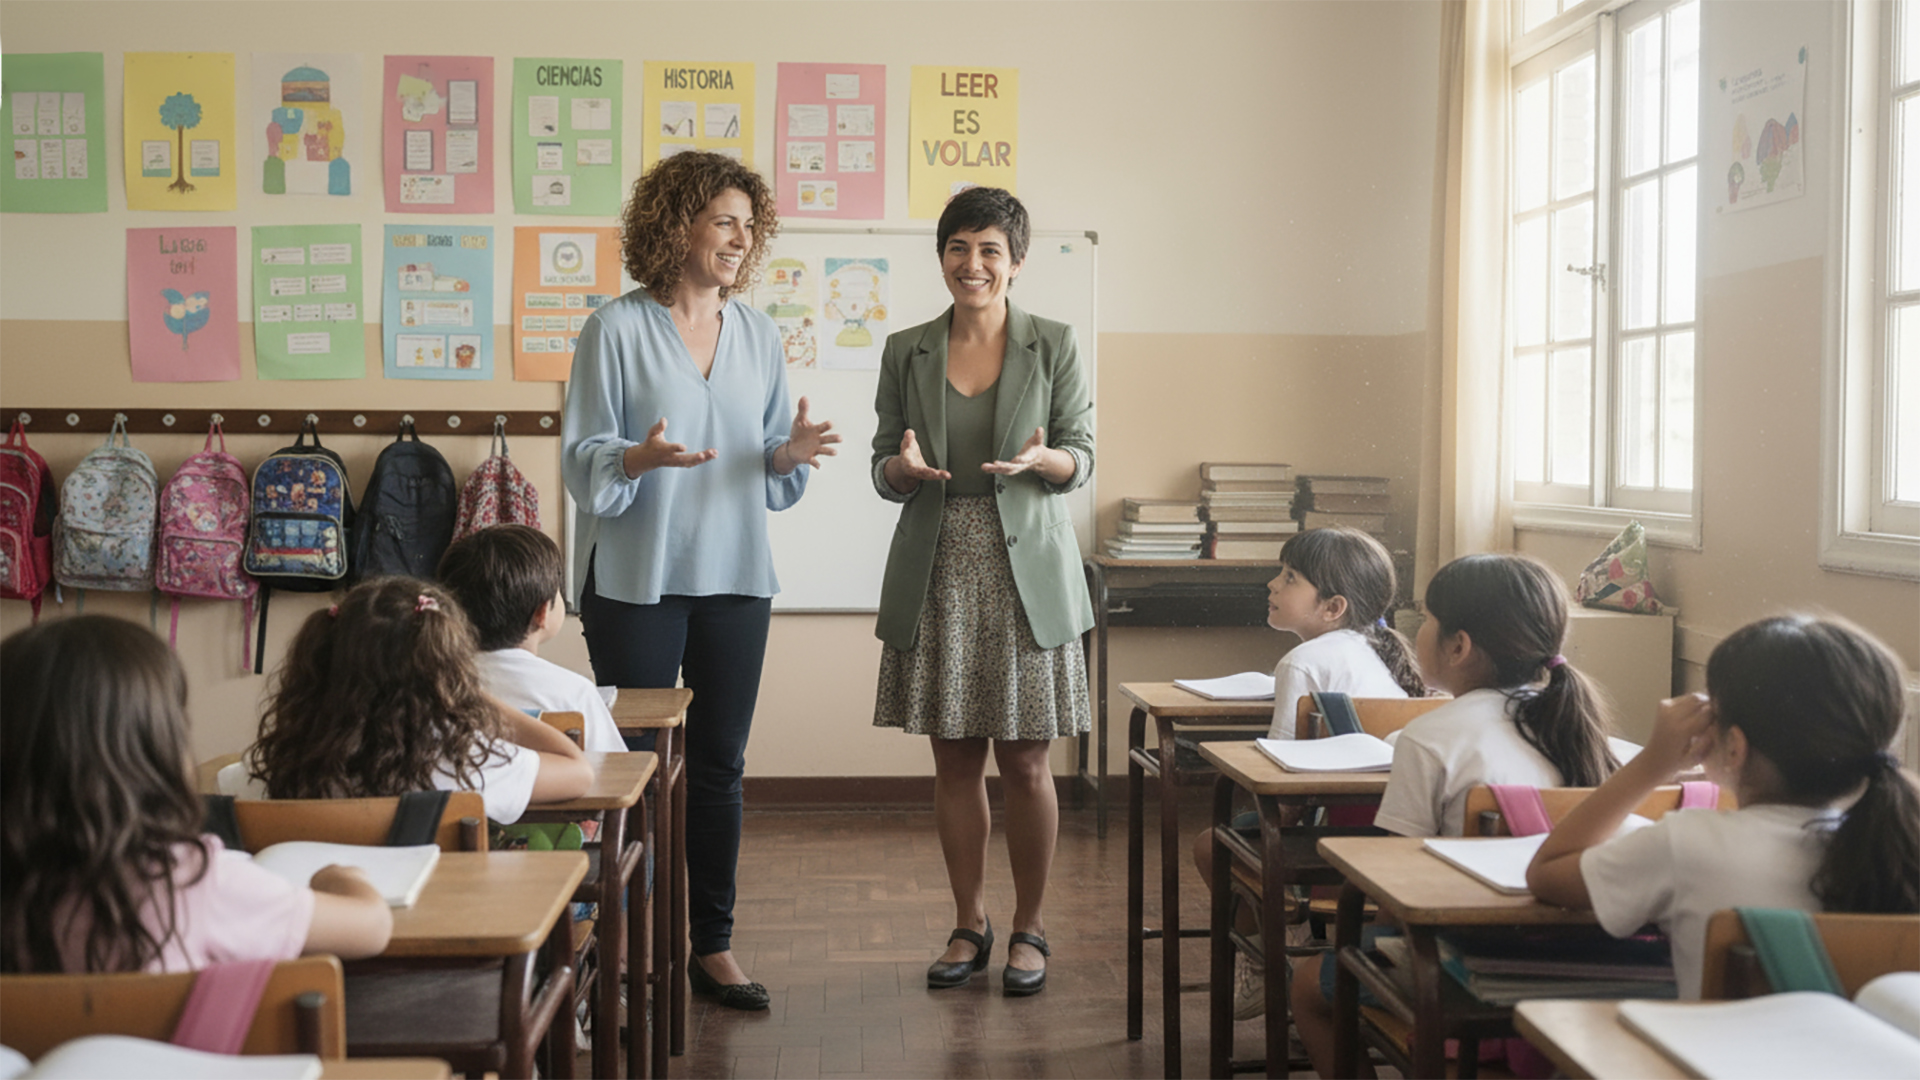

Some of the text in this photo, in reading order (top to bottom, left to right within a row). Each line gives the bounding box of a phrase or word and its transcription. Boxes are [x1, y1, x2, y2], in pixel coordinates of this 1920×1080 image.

[537, 65, 602, 87] CIENCIAS
[664, 68, 734, 90] HISTORIA
[941, 72, 998, 98] LEER
[953, 110, 980, 135] ES
[922, 140, 1011, 167] VOLAR
